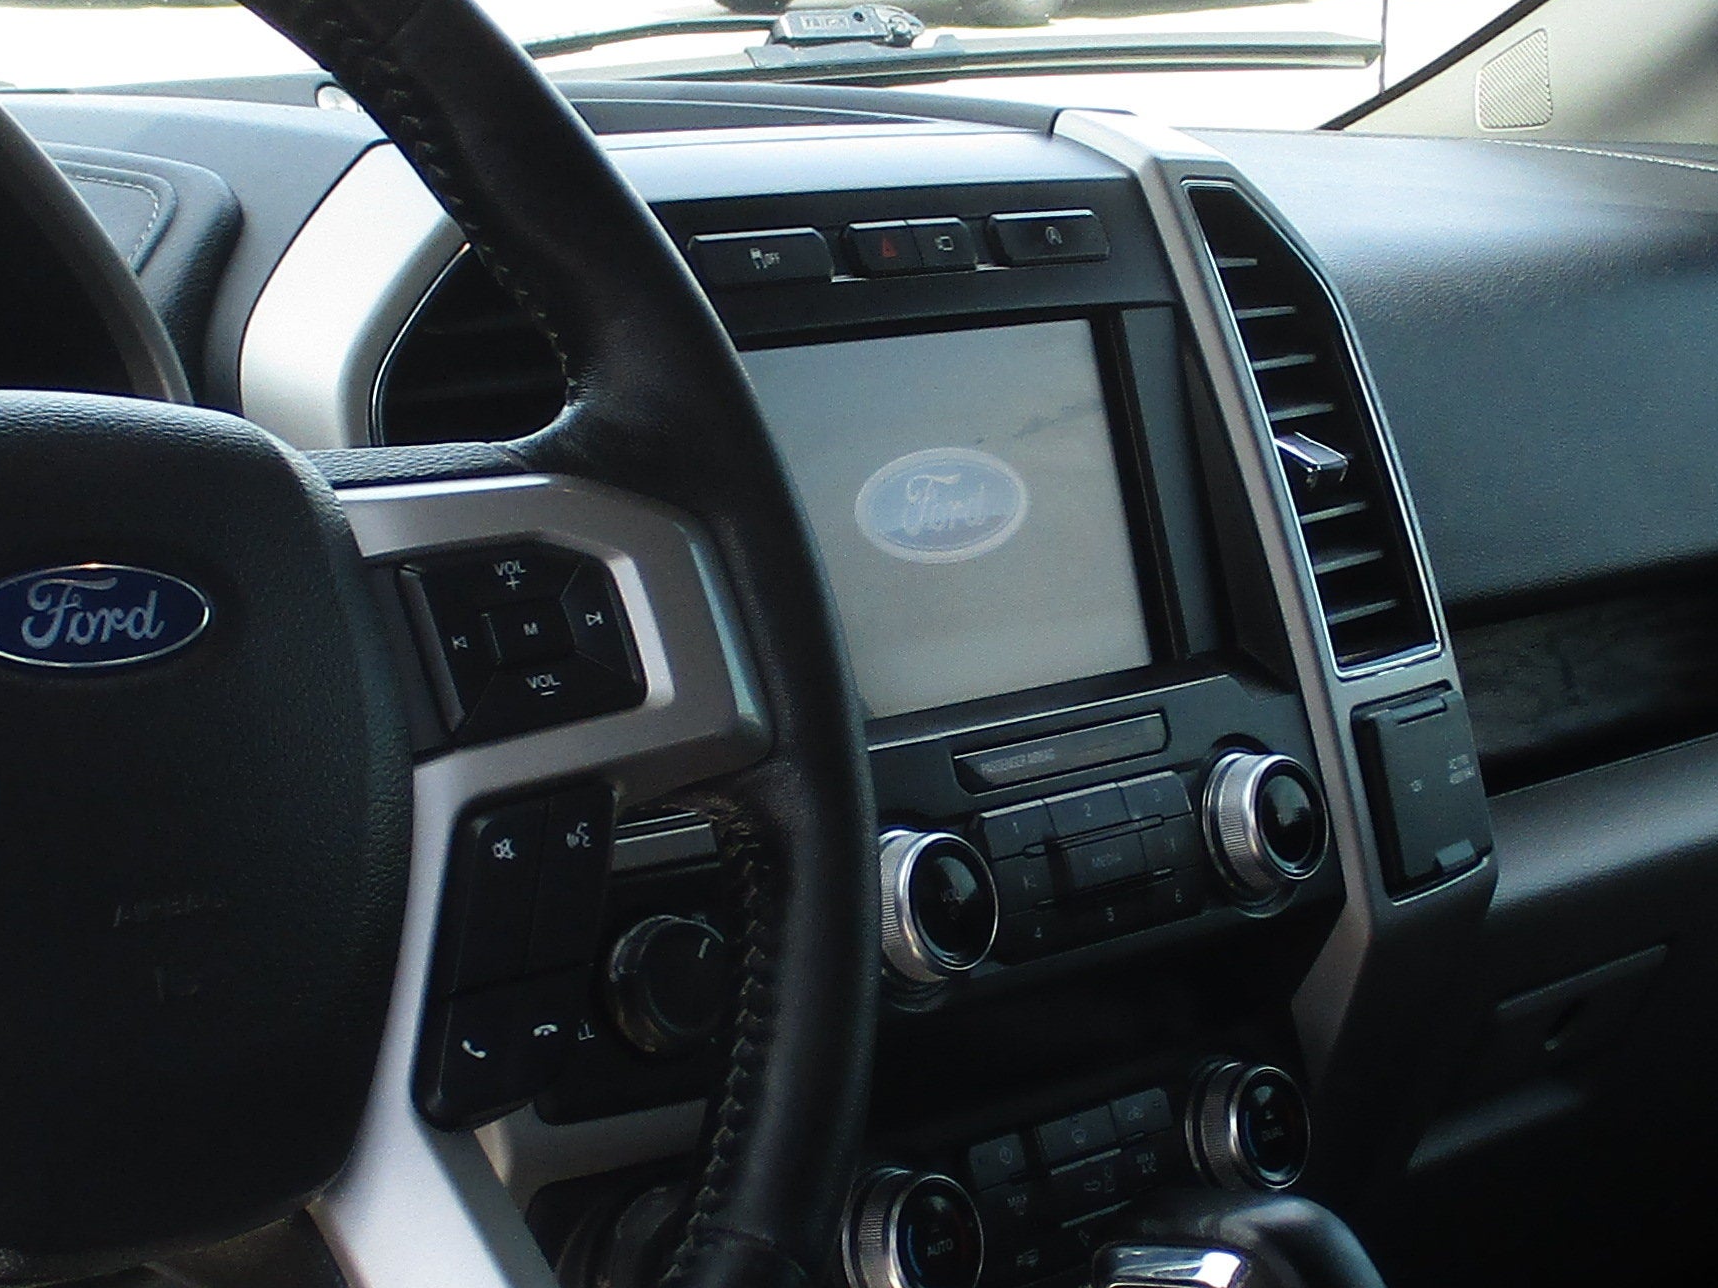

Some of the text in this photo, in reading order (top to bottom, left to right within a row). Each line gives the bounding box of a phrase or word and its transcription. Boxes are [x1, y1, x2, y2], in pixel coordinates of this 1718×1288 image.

[902, 472, 987, 537] Ford
[493, 559, 528, 577] VOL
[20, 576, 166, 649] Ford
[522, 621, 540, 637] M
[525, 672, 562, 690] VOL
[1084, 803, 1093, 818] 2
[1174, 889, 1183, 904] 6
[1106, 908, 1115, 923] 5
[1034, 926, 1043, 940] 4
[926, 1237, 955, 1258] AUTO
